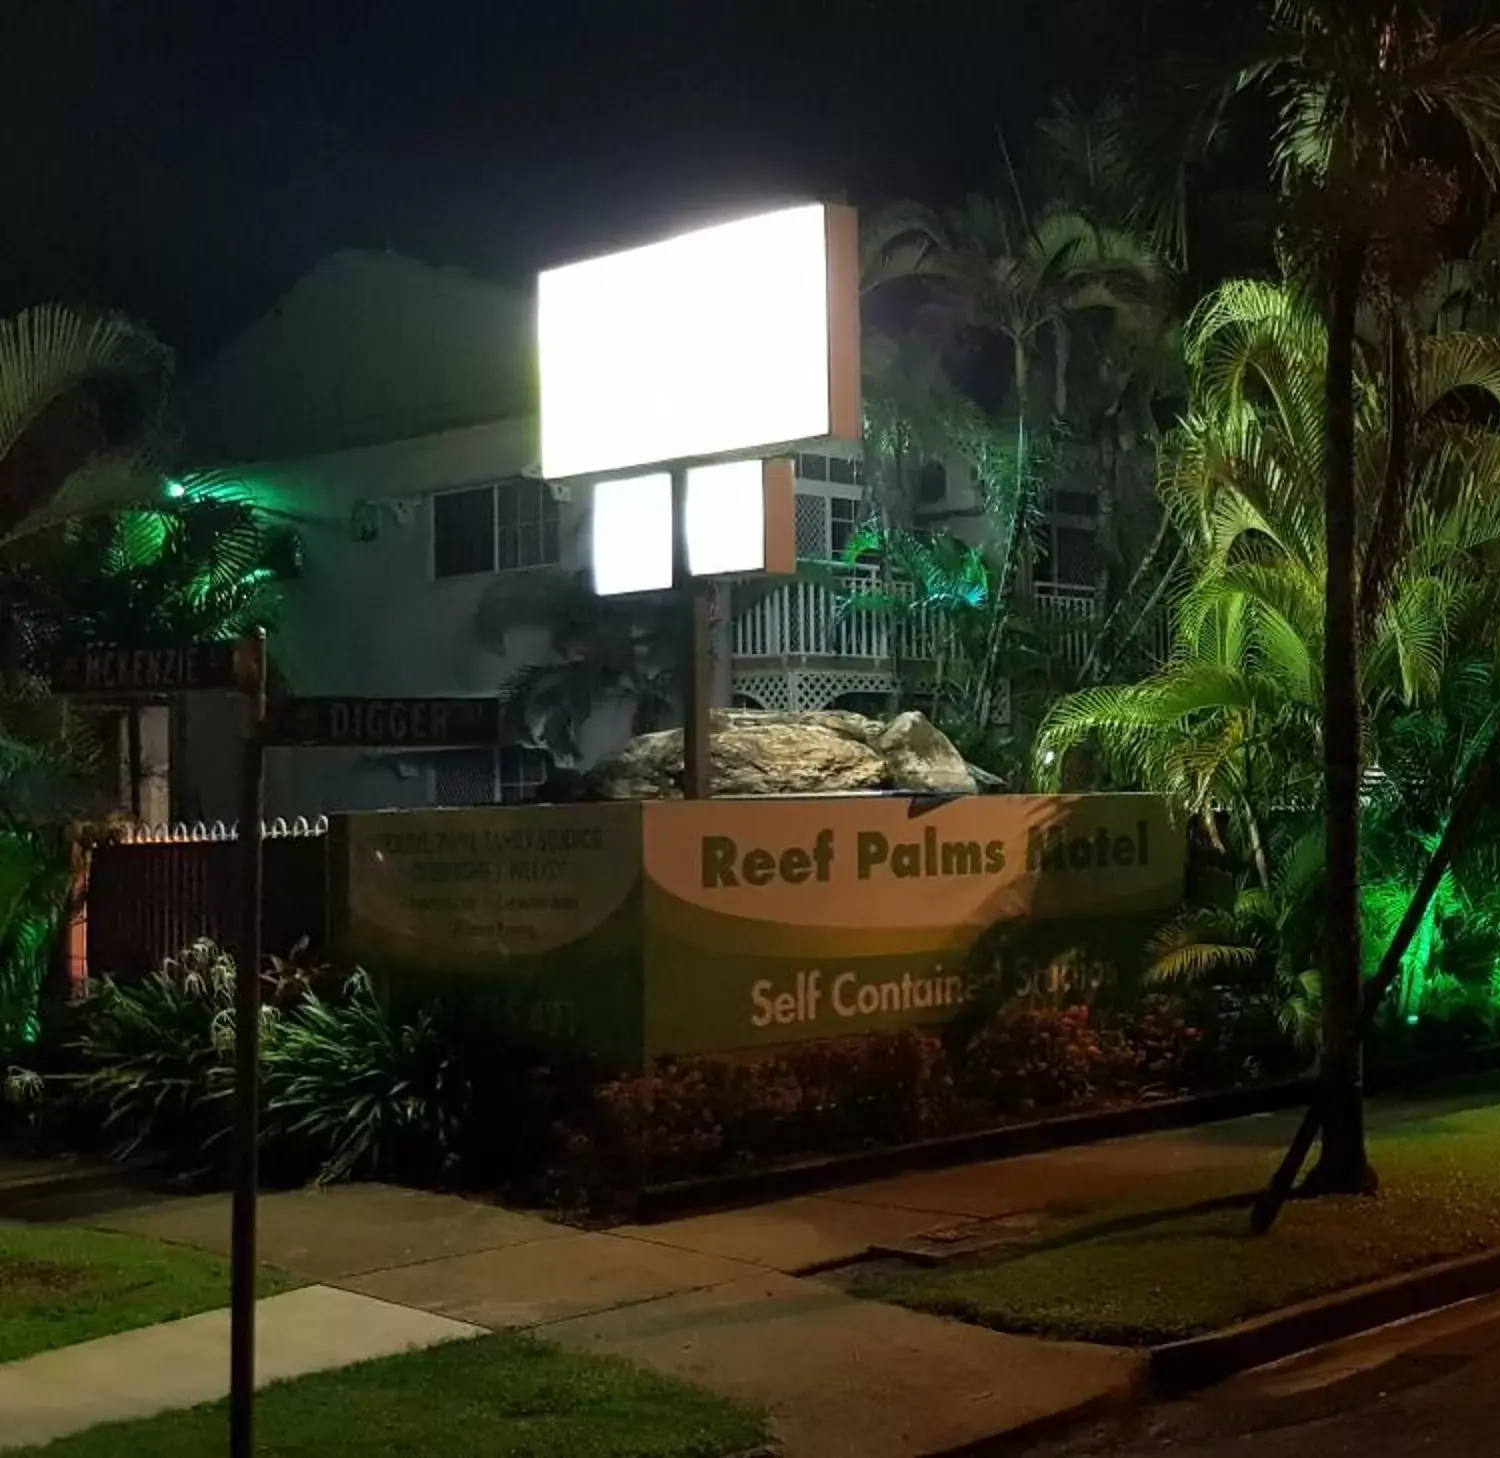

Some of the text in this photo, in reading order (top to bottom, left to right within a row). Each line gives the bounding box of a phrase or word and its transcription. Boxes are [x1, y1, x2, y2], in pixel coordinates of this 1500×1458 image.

[84, 648, 199, 688] MCKENZIE
[331, 702, 447, 738] DIGGER
[702, 820, 1148, 888] Reef Palms Motel
[752, 969, 822, 1027] Self
